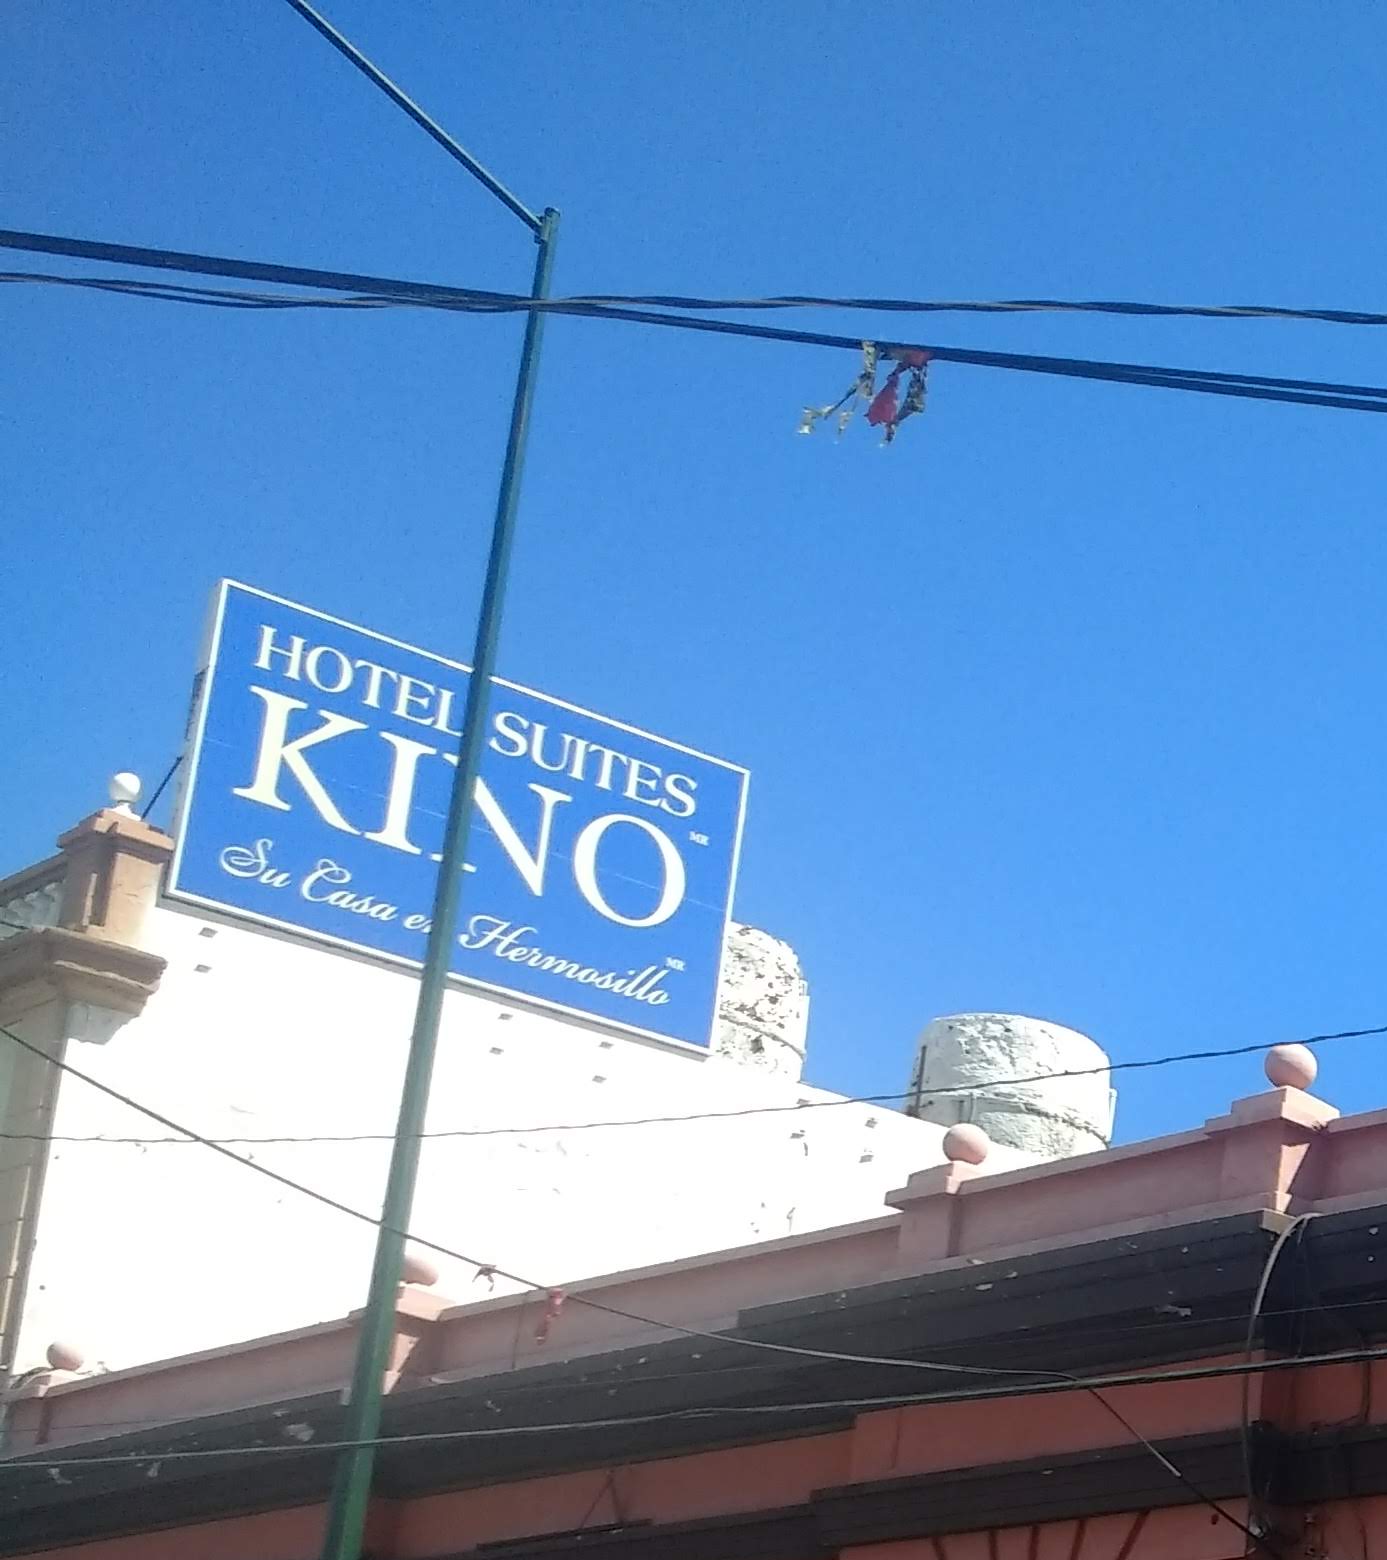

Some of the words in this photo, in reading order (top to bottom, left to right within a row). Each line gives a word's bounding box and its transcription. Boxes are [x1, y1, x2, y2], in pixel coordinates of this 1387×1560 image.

[232, 684, 687, 928] KINO
[253, 624, 463, 738] HOTEL
[489, 711, 697, 818] SUITES
[219, 837, 291, 889] Su
[301, 857, 398, 922] Casa
[459, 912, 672, 1007] Hermosillo
